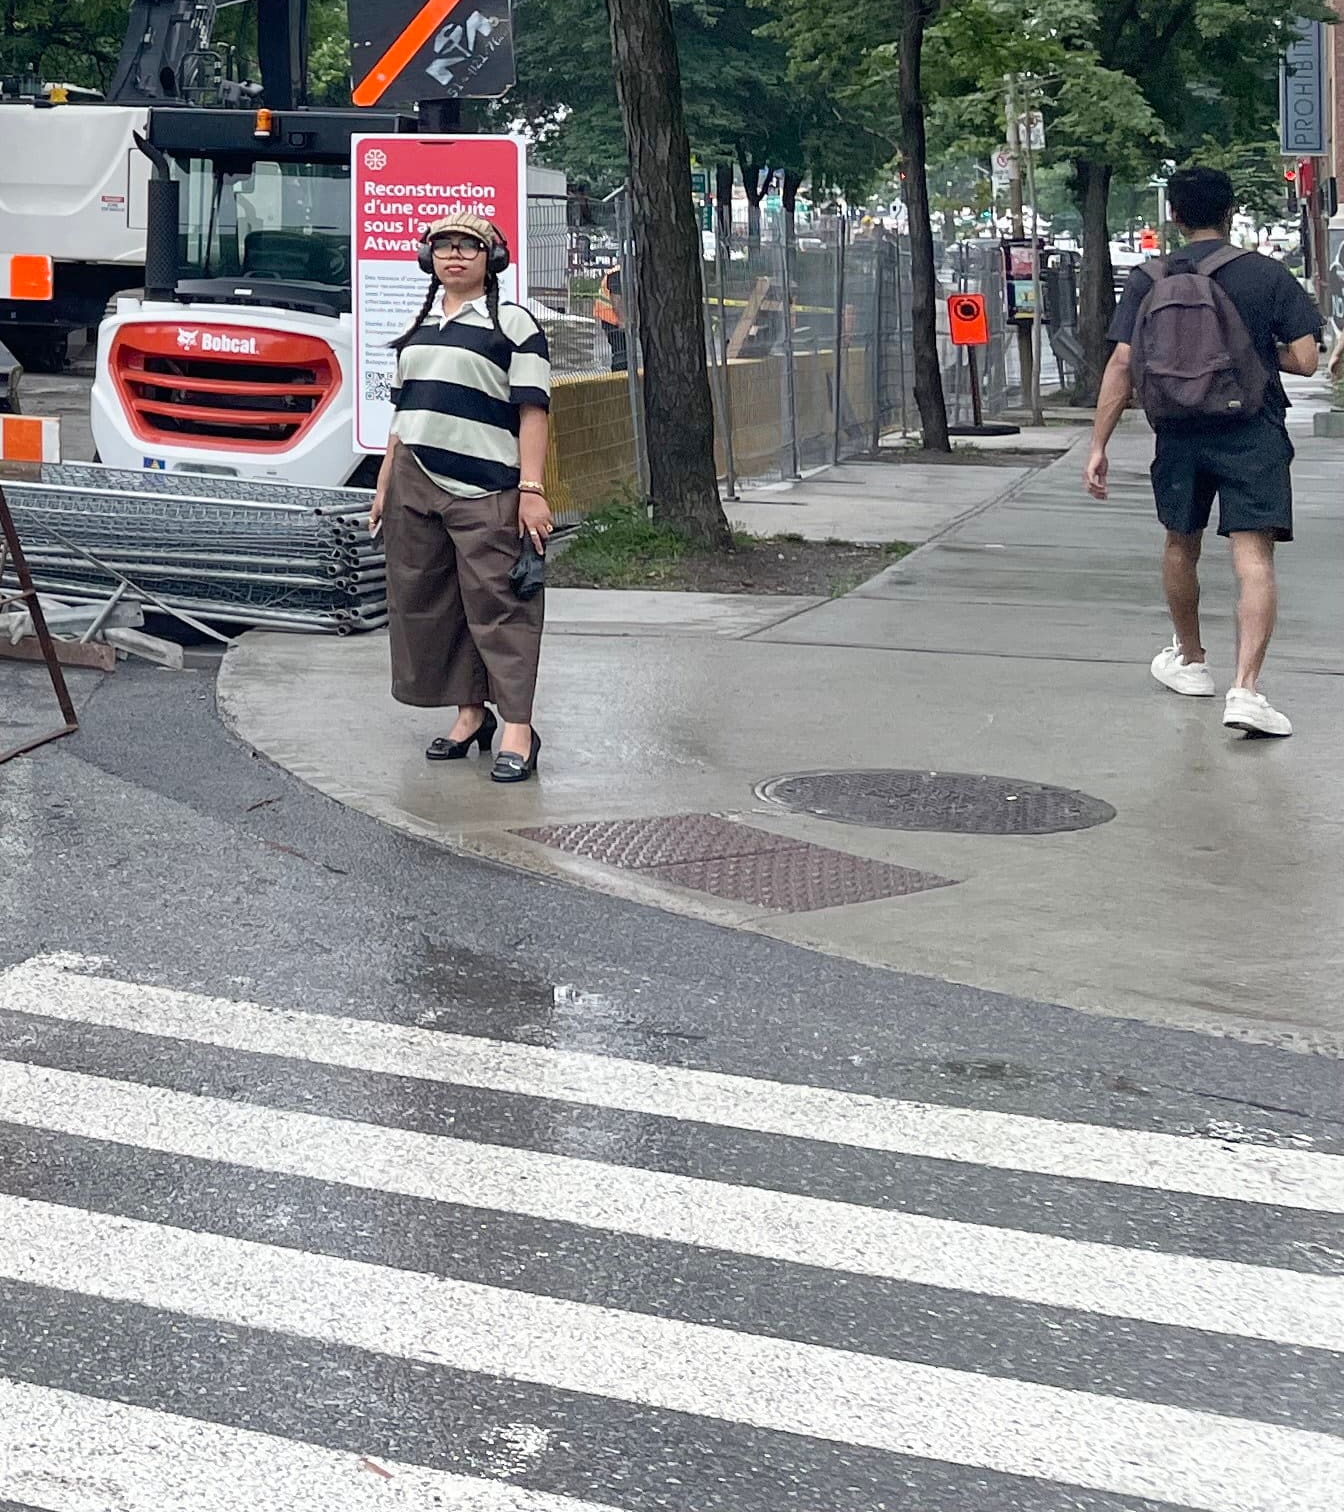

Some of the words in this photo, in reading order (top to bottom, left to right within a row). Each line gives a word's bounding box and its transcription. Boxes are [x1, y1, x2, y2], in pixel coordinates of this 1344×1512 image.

[364, 181, 496, 199] Reconstruction
[364, 199, 414, 216] d'une
[418, 200, 496, 218] conduite
[364, 221, 404, 234] sous
[364, 237, 424, 252] Atwat
[202, 332, 257, 355] Bobcat
